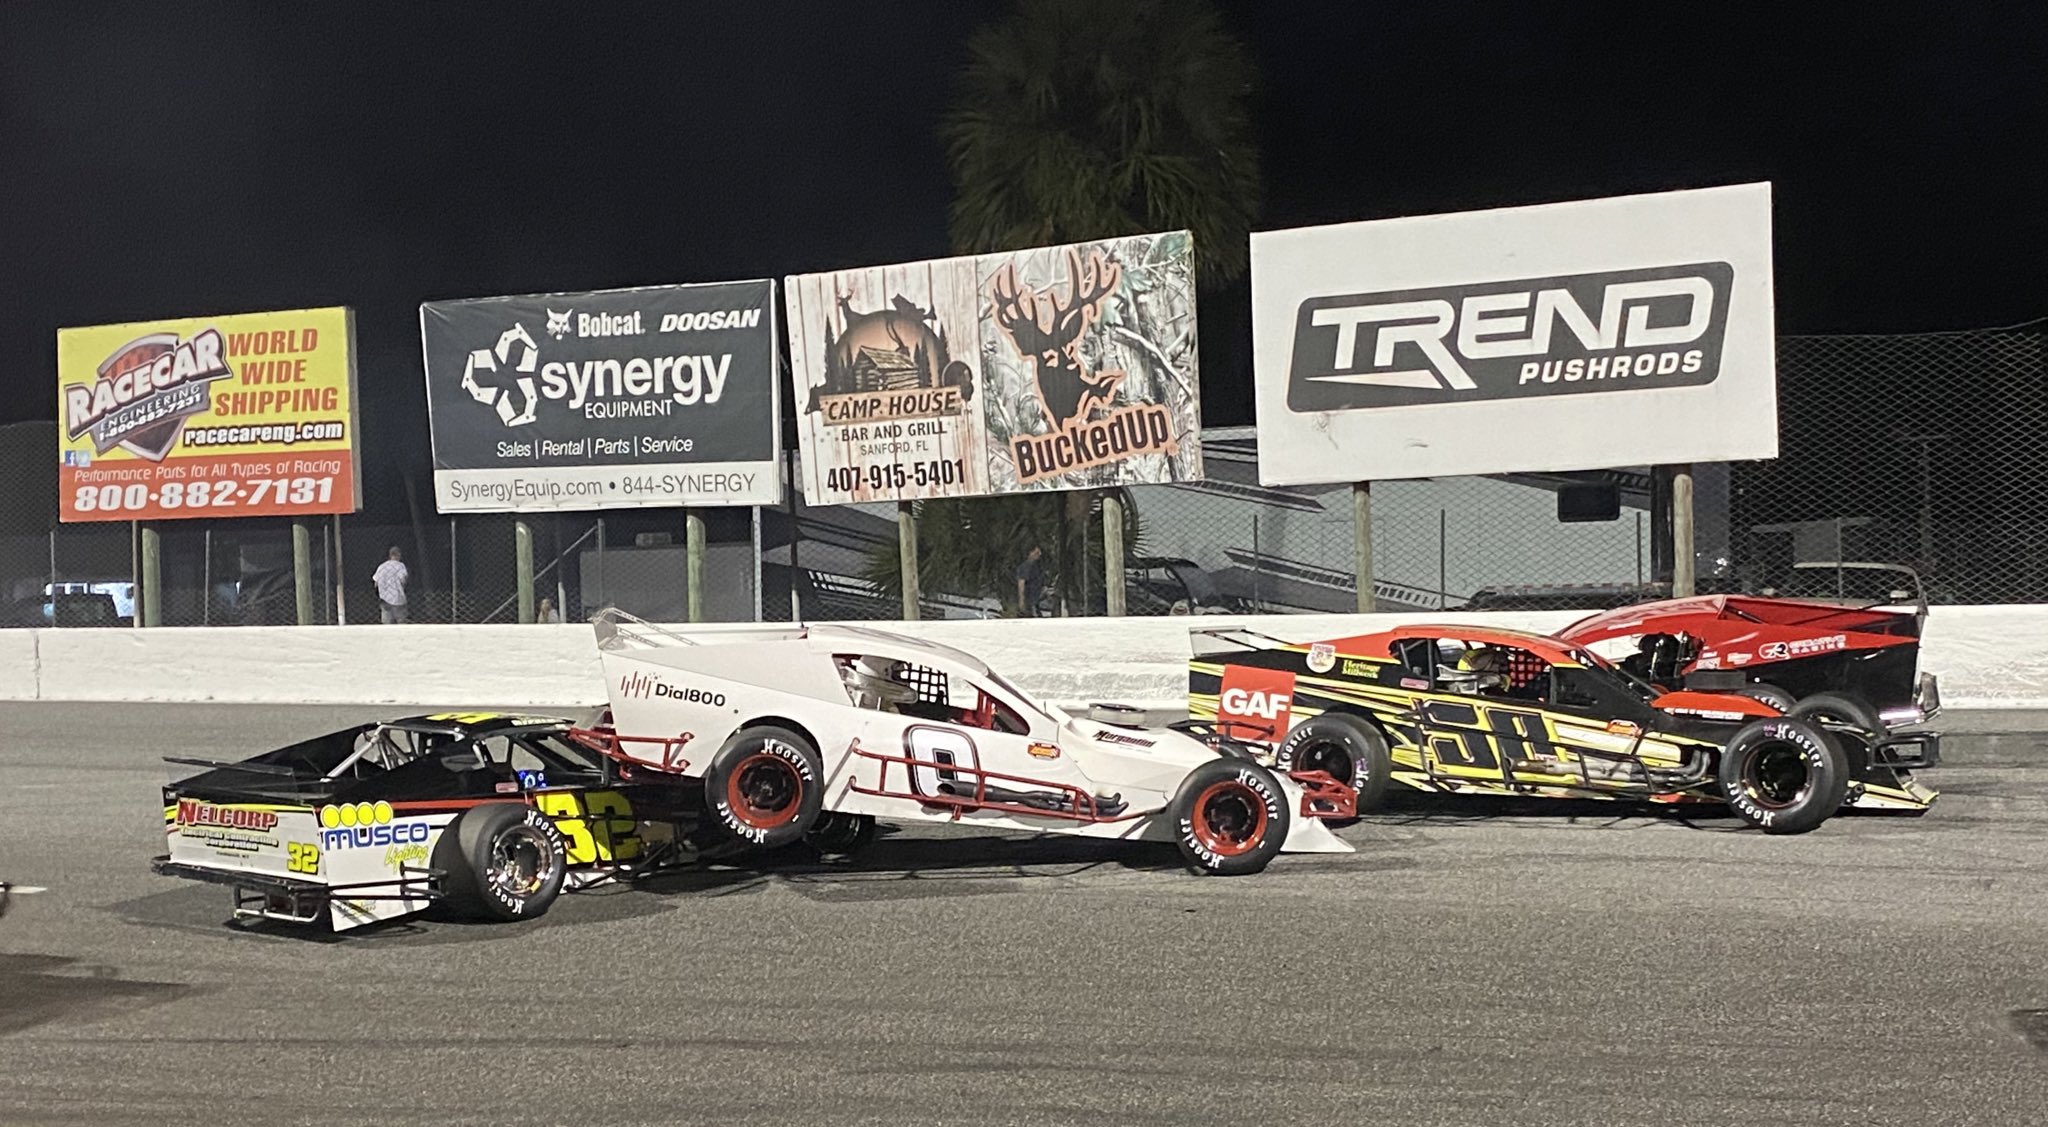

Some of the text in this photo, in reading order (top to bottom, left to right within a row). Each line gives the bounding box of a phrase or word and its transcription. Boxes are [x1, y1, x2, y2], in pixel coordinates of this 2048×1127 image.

[660, 308, 761, 333] DOOSAN
[1311, 276, 1714, 390] TREND
[228, 328, 318, 357] WORLD
[66, 328, 224, 432] RACECAR
[240, 359, 307, 385] WIDE
[541, 354, 732, 409] synergy
[1518, 350, 1703, 385] PUSHRODS
[101, 384, 200, 431] ENGINEERING
[215, 387, 338, 416] SHIPPING
[585, 400, 673, 419] EQUIPMENT
[827, 392, 957, 421] CAMP HOUSE
[184, 422, 343, 446] racecareng.com
[497, 436, 693, 458] Sales Rental Parts Service
[841, 421, 948, 441] BAR AND GRILL
[1015, 410, 1169, 479] BuckedUp
[860, 441, 929, 456] SANFORD, FL
[75, 460, 341, 483] Performance Parts for All Types of Racing
[451, 473, 756, 502] SynergyEquip.com 844-SYNERGY
[827, 459, 966, 493] 407-915-5401
[655, 683, 726, 707] Dial800
[1222, 688, 1290, 719] GAF
[761, 739, 813, 781] Hoosier
[1278, 727, 1313, 772] Hoosier
[1774, 724, 1824, 768] Hoosier
[1235, 769, 1279, 820] Hoosier
[1727, 782, 1776, 827] Hoosier
[176, 799, 279, 832] NELCORP
[536, 791, 642, 864] 32
[717, 802, 768, 844] Hoosier
[324, 823, 429, 851] MUSCO
[524, 810, 564, 855] Hoosier
[1180, 818, 1225, 869] Hoosier
[288, 842, 320, 875] 32
